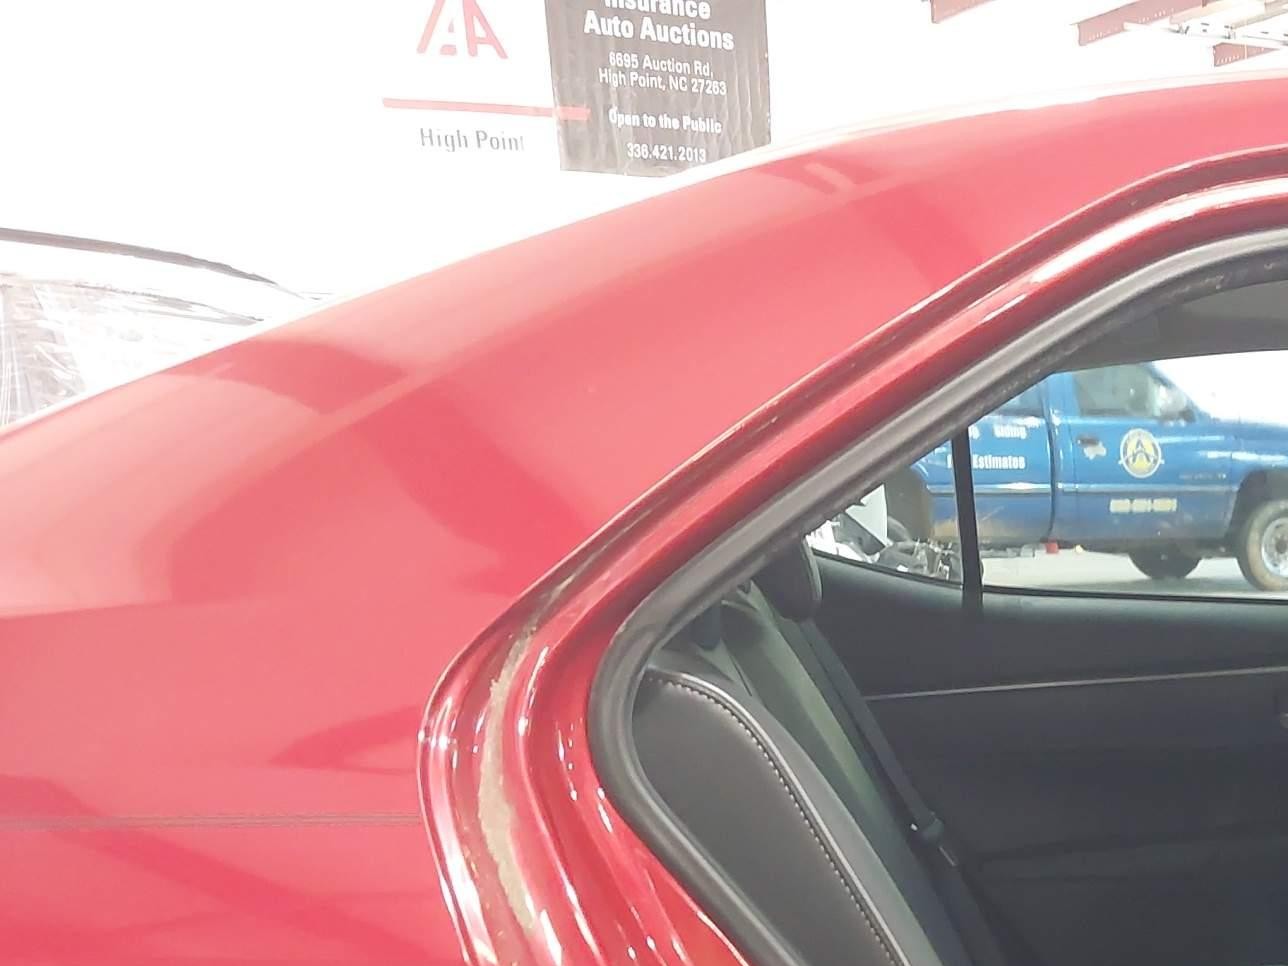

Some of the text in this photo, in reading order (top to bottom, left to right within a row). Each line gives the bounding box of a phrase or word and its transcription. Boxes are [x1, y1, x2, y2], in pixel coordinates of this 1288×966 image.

[584, 10, 735, 50] Auto Auctions
[609, 52, 639, 69] 6695
[643, 55, 691, 75] Auction
[599, 67, 727, 95] High Point, NC 27263
[609, 107, 722, 134] Open to the Public
[420, 128, 468, 152] High
